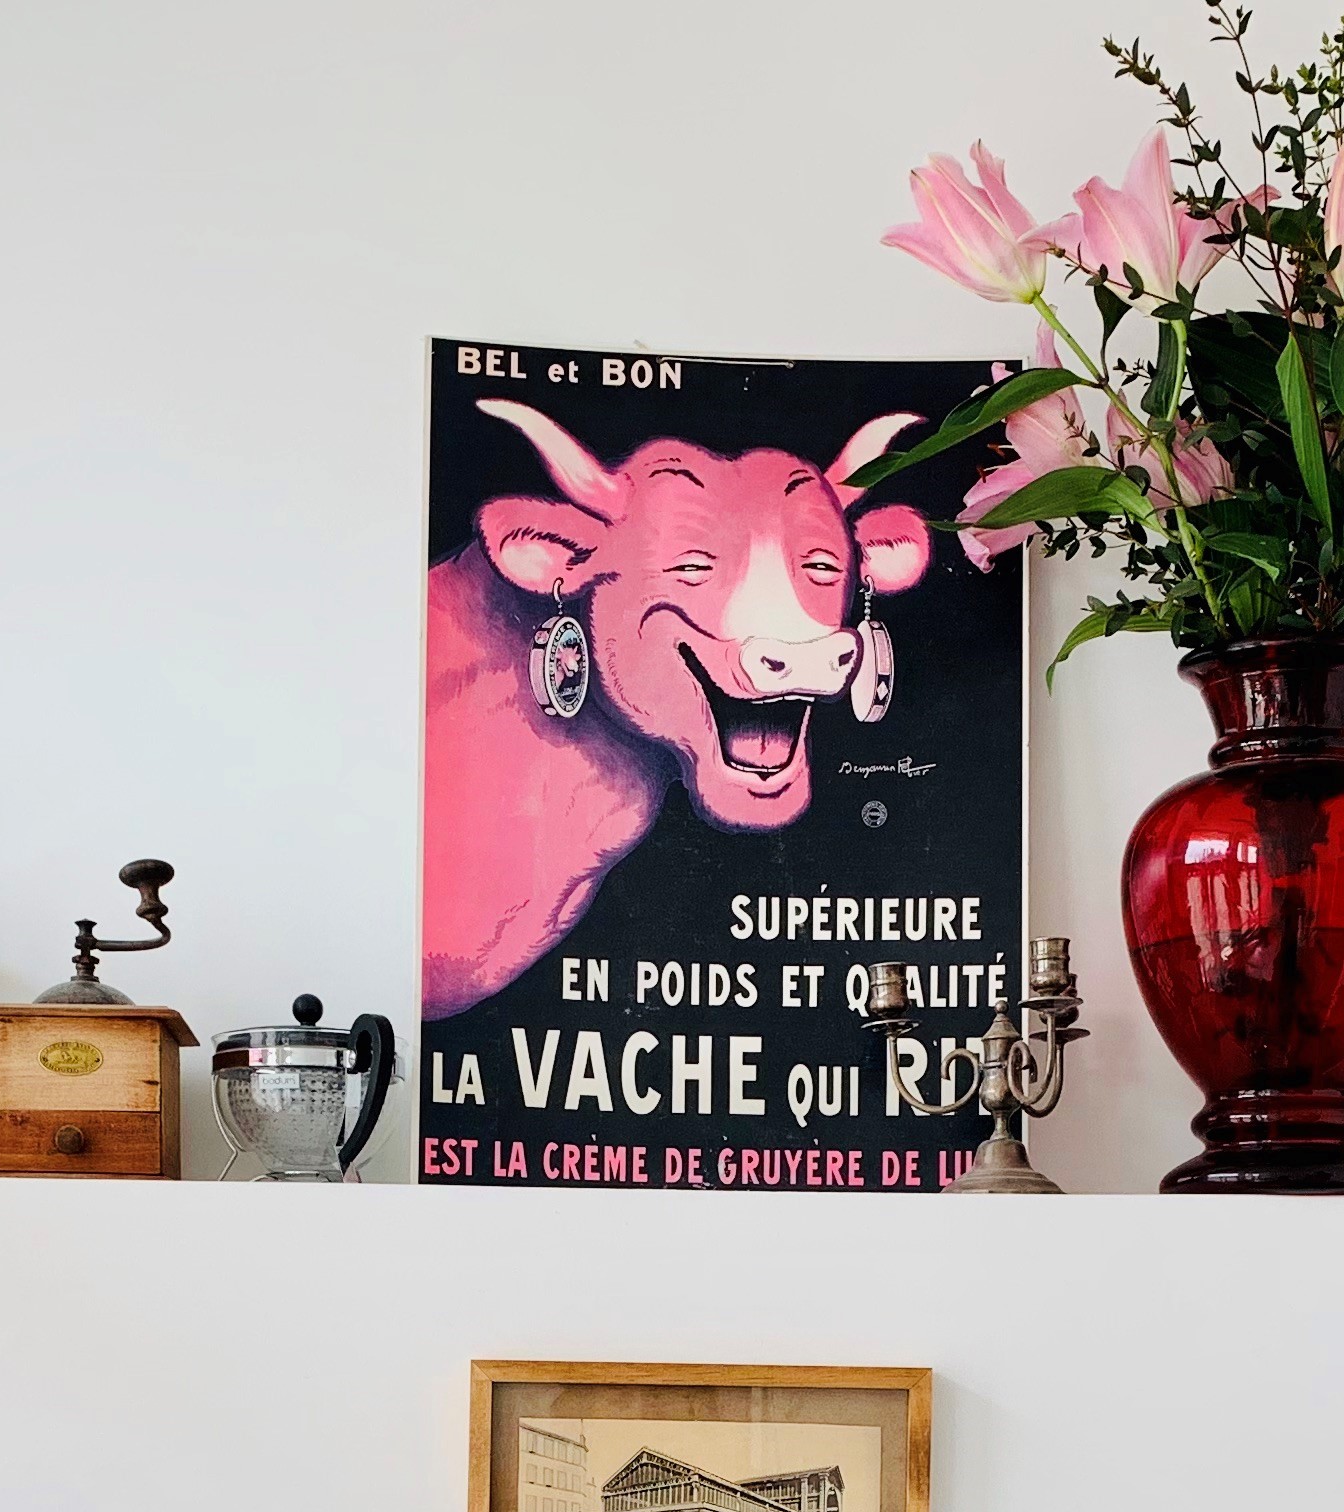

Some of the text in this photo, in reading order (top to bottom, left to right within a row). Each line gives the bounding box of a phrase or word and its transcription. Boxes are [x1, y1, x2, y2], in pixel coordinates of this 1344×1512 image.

[457, 346, 682, 390] BEL et BON
[730, 884, 982, 941] SUPÉRIEURE
[562, 952, 1008, 1018] EN POIDS ET QALITÉ
[432, 1051, 486, 1105] LA
[511, 1027, 766, 1116] VACHE
[787, 1063, 859, 1128] QUI
[424, 1137, 478, 1176] EST
[494, 1140, 528, 1178] LA
[543, 1133, 648, 1183] CRÈME
[665, 1147, 703, 1184] DE
[717, 1138, 865, 1186] GRUYÈRE
[882, 1150, 921, 1187] DE
